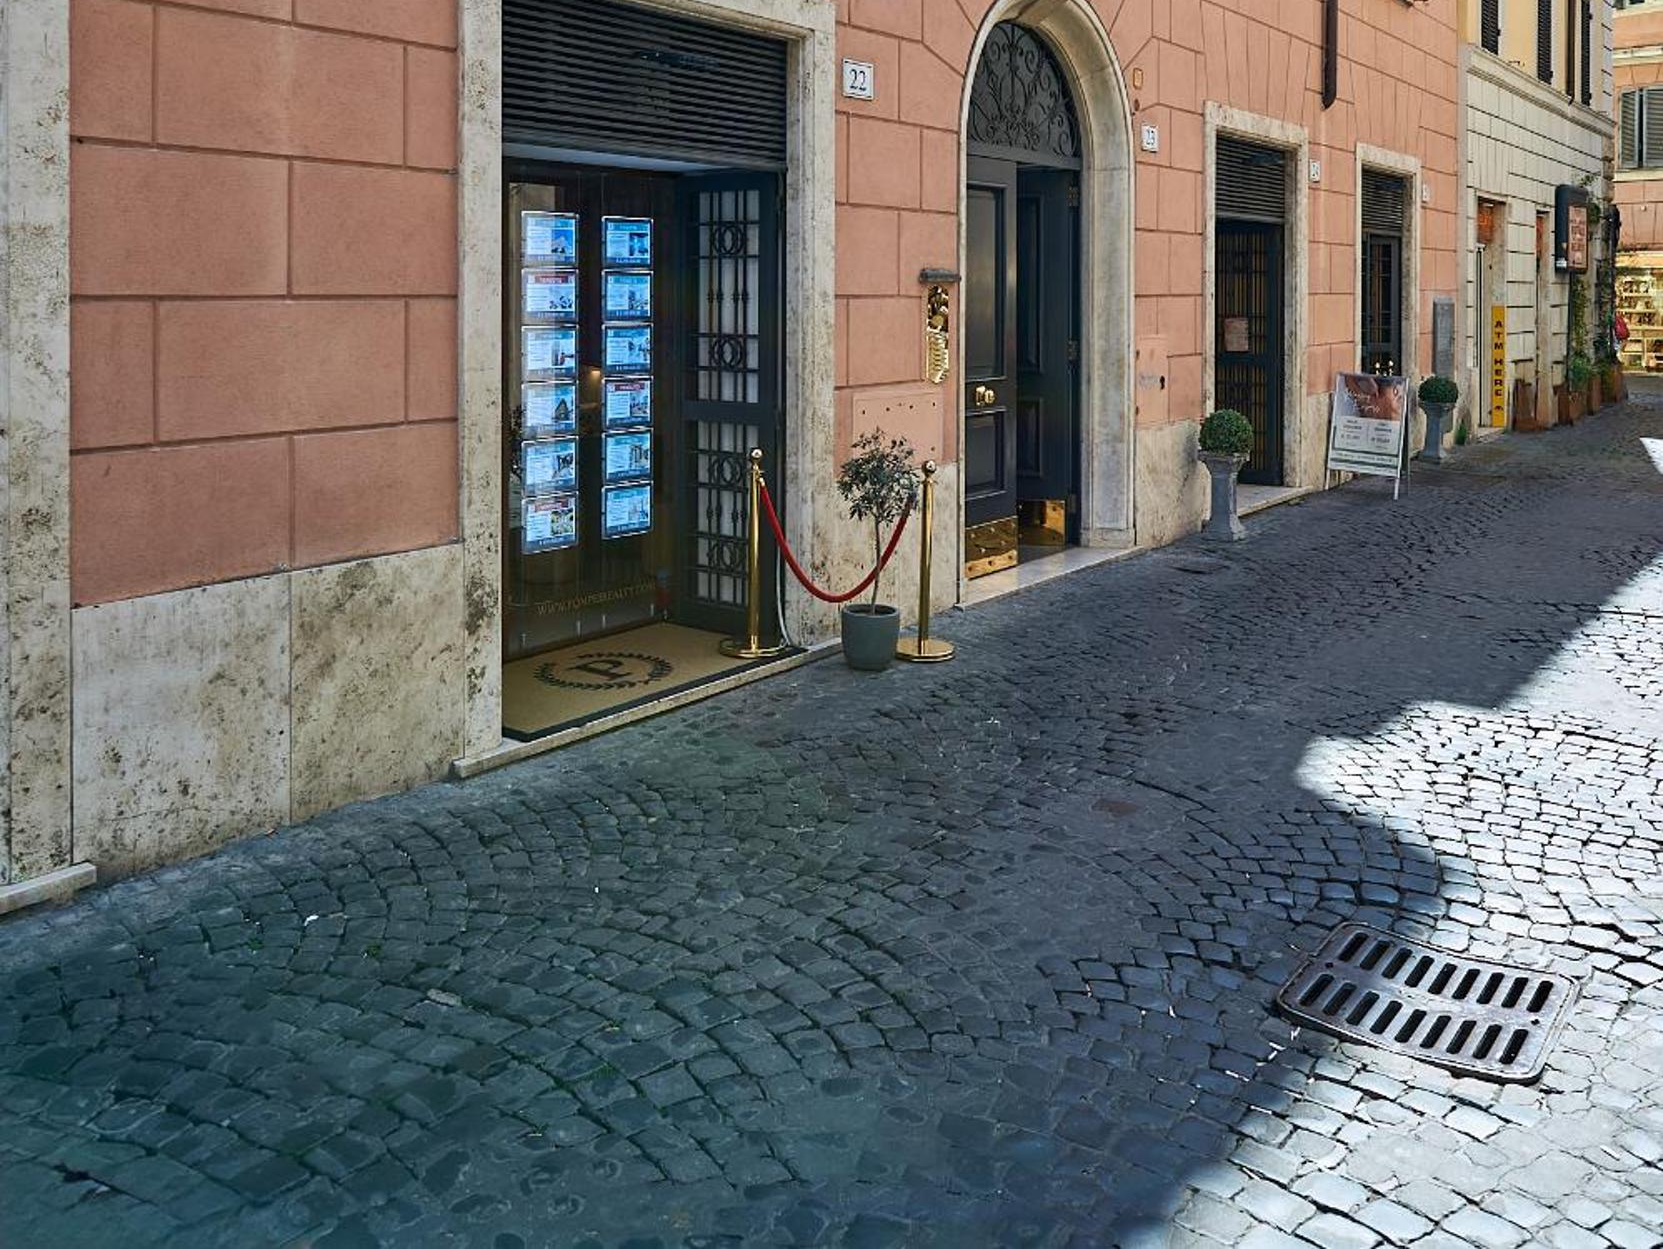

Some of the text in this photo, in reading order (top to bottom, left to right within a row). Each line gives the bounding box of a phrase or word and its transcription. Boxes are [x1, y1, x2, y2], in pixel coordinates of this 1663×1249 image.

[849, 68, 867, 92] 22
[1494, 320, 1504, 397] ATM HERE
